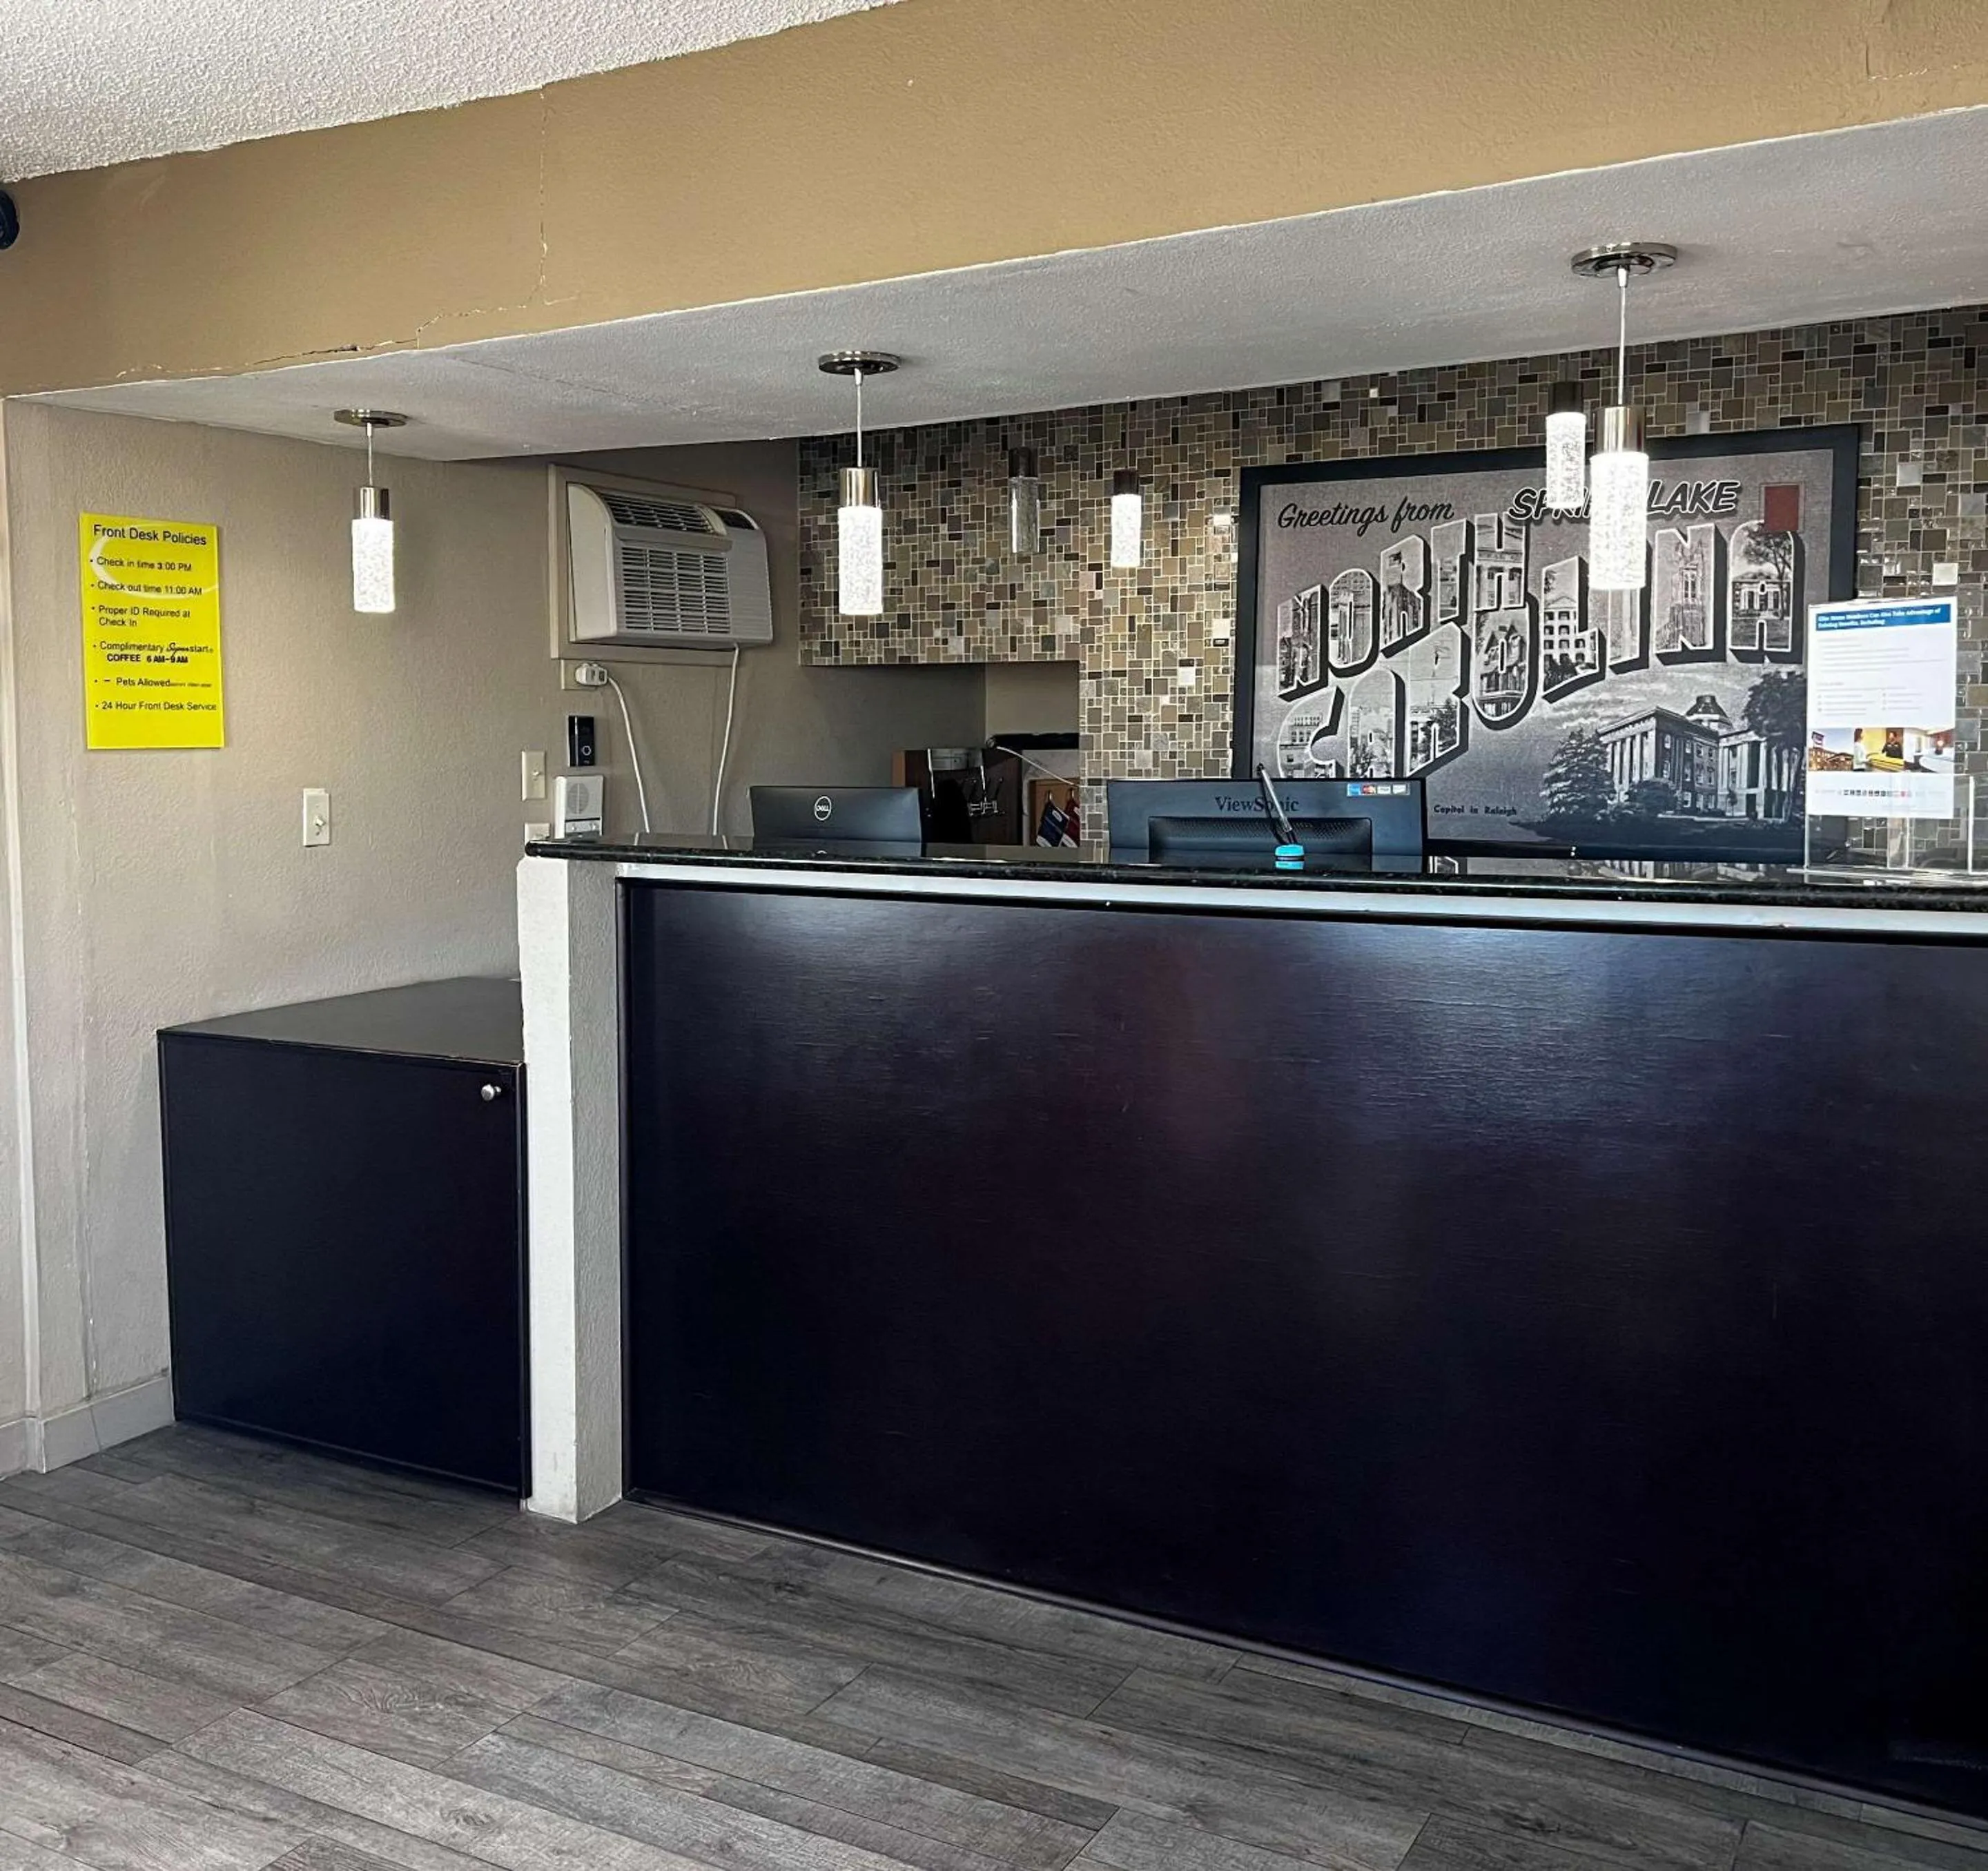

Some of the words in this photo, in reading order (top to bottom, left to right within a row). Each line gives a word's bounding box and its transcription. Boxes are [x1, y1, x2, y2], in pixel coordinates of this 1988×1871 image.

[1647, 479, 1741, 516] LAKE
[1278, 502, 1389, 537] Greetings
[1390, 496, 1454, 533] from
[93, 524, 126, 538] Front
[129, 527, 159, 541] Desk
[163, 531, 206, 545] Policies
[97, 556, 124, 567] Check
[127, 558, 134, 567] in
[137, 560, 155, 569] time
[157, 562, 175, 571] 3:00
[179, 562, 192, 571] PM
[97, 580, 125, 590] Check
[144, 584, 162, 593] time
[165, 586, 186, 594] 11:00
[188, 587, 202, 596] AM
[99, 605, 127, 616] Proper
[130, 607, 139, 615] ID
[143, 607, 180, 618] Required
[1277, 513, 1531, 701] NORTH
[99, 617, 126, 626] Check
[100, 640, 164, 653] Complimentary
[107, 654, 141, 662] COFFEE
[116, 677, 135, 686] Pets
[137, 678, 170, 687] Allowed
[115, 701, 137, 709] Hour
[139, 701, 161, 709] Front
[164, 702, 184, 710] Desk
[187, 702, 217, 711] Service
[1434, 804, 1465, 814] Capitol
[1470, 805, 1479, 814] in
[1484, 805, 1517, 816] Raleigh
